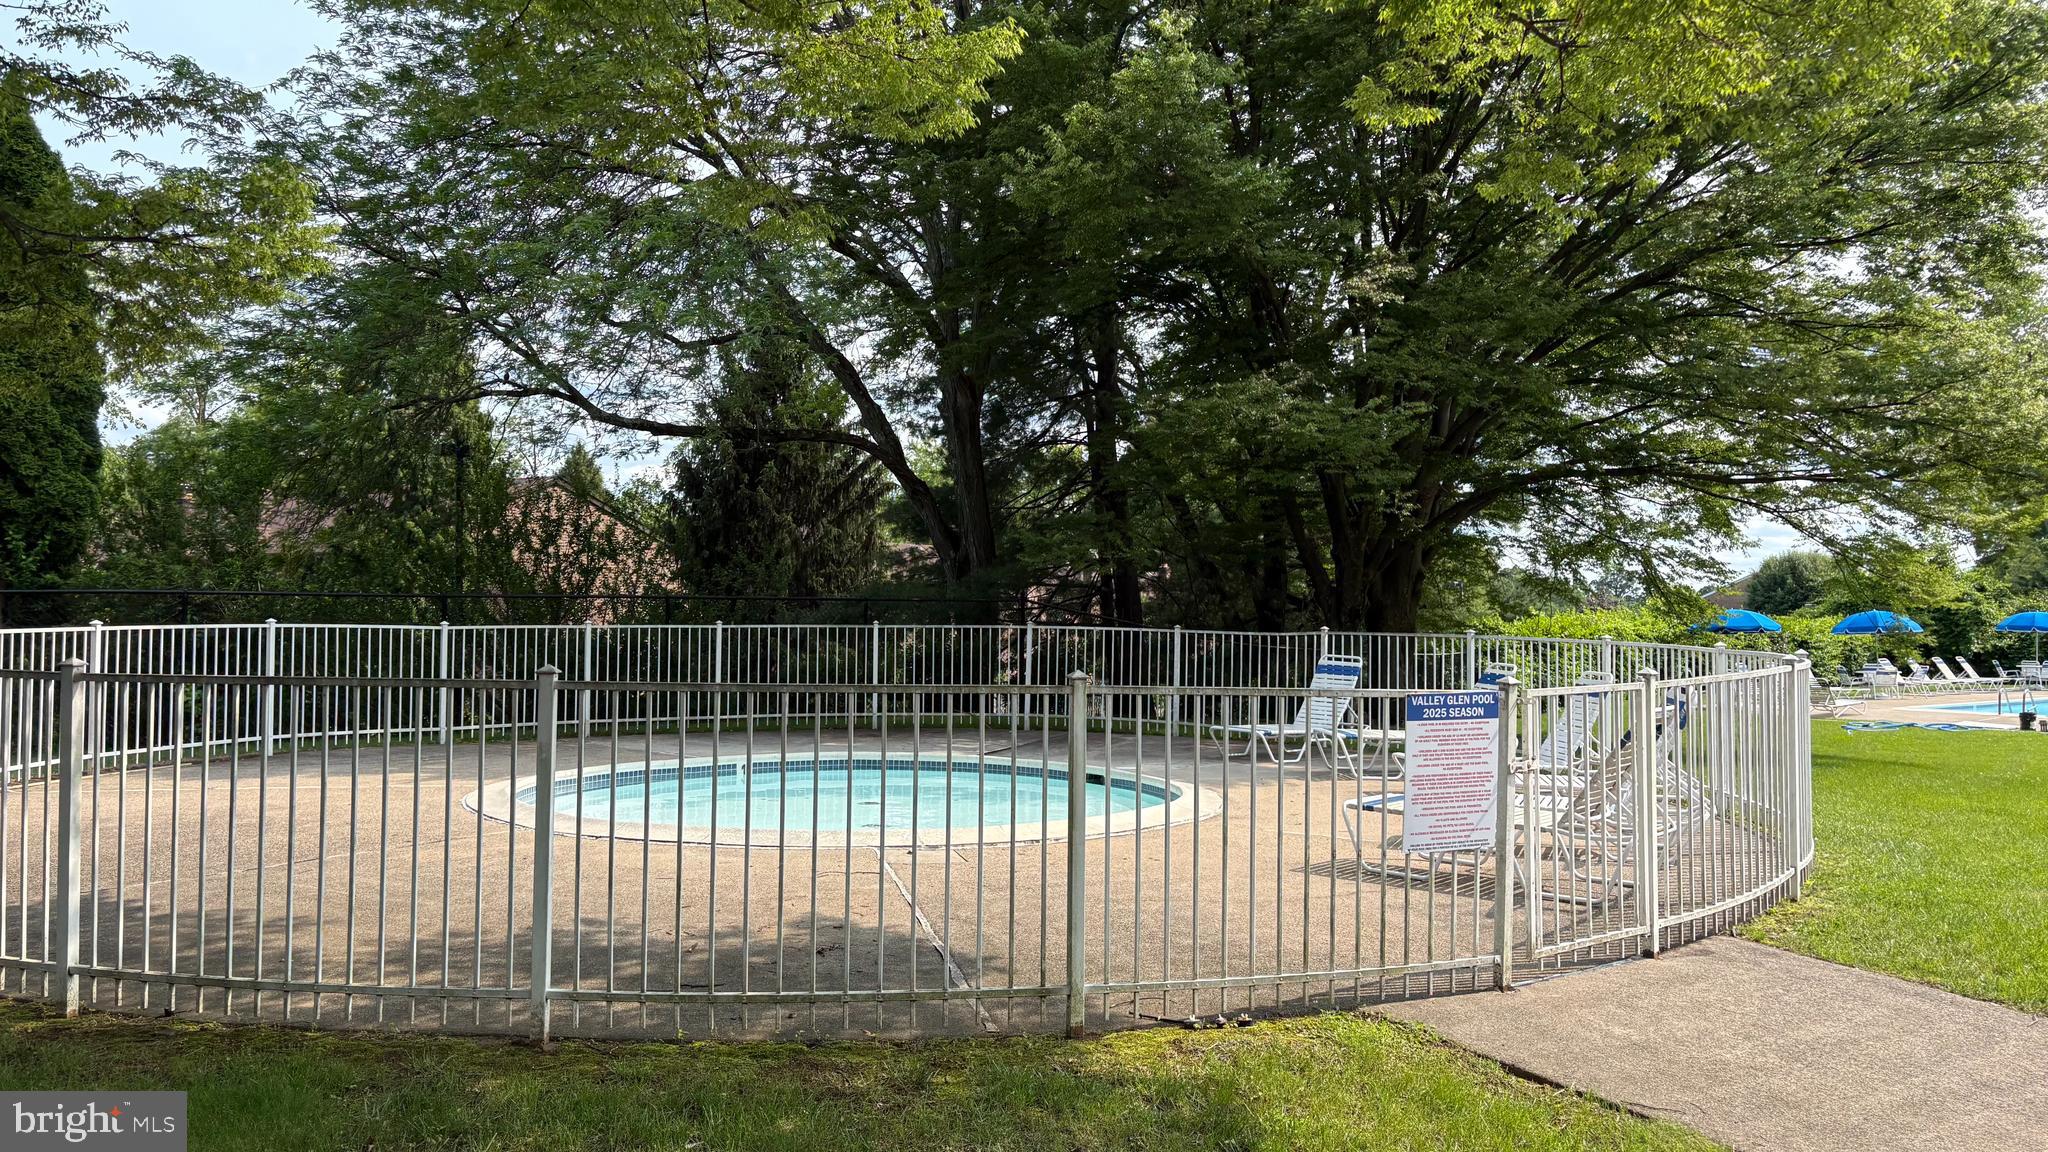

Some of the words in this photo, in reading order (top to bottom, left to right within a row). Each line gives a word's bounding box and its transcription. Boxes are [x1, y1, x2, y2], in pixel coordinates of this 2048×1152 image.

[1411, 695, 1445, 706] VALLEY
[1447, 694, 1470, 705] GLEN
[1472, 694, 1495, 704] POOL
[1423, 708, 1447, 718] 2025
[1448, 707, 1485, 718] SEASON
